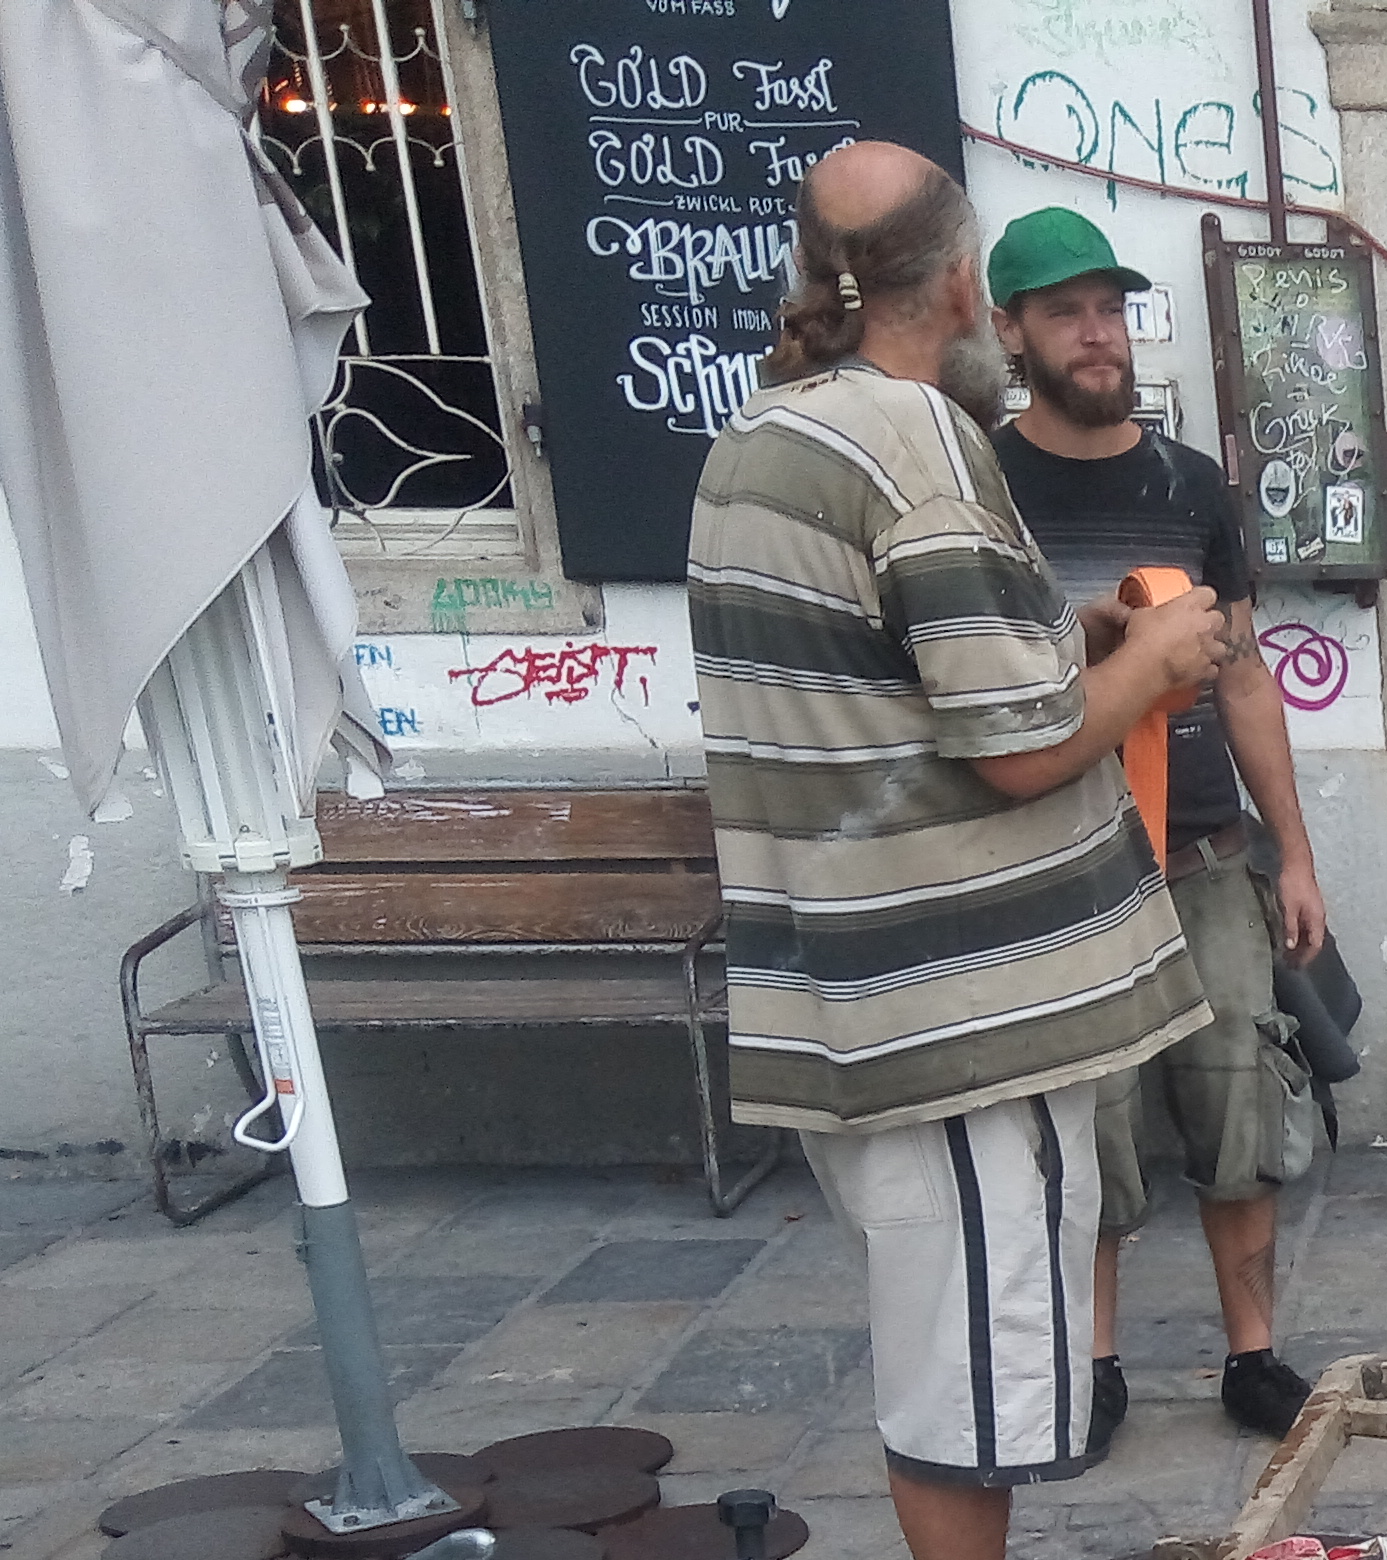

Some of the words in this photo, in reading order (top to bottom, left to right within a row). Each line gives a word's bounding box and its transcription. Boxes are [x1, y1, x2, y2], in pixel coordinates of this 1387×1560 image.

[570, 43, 707, 109] GOLD
[704, 111, 743, 132] PUR
[588, 130, 724, 188] GOLD
[640, 303, 717, 329] SESSION
